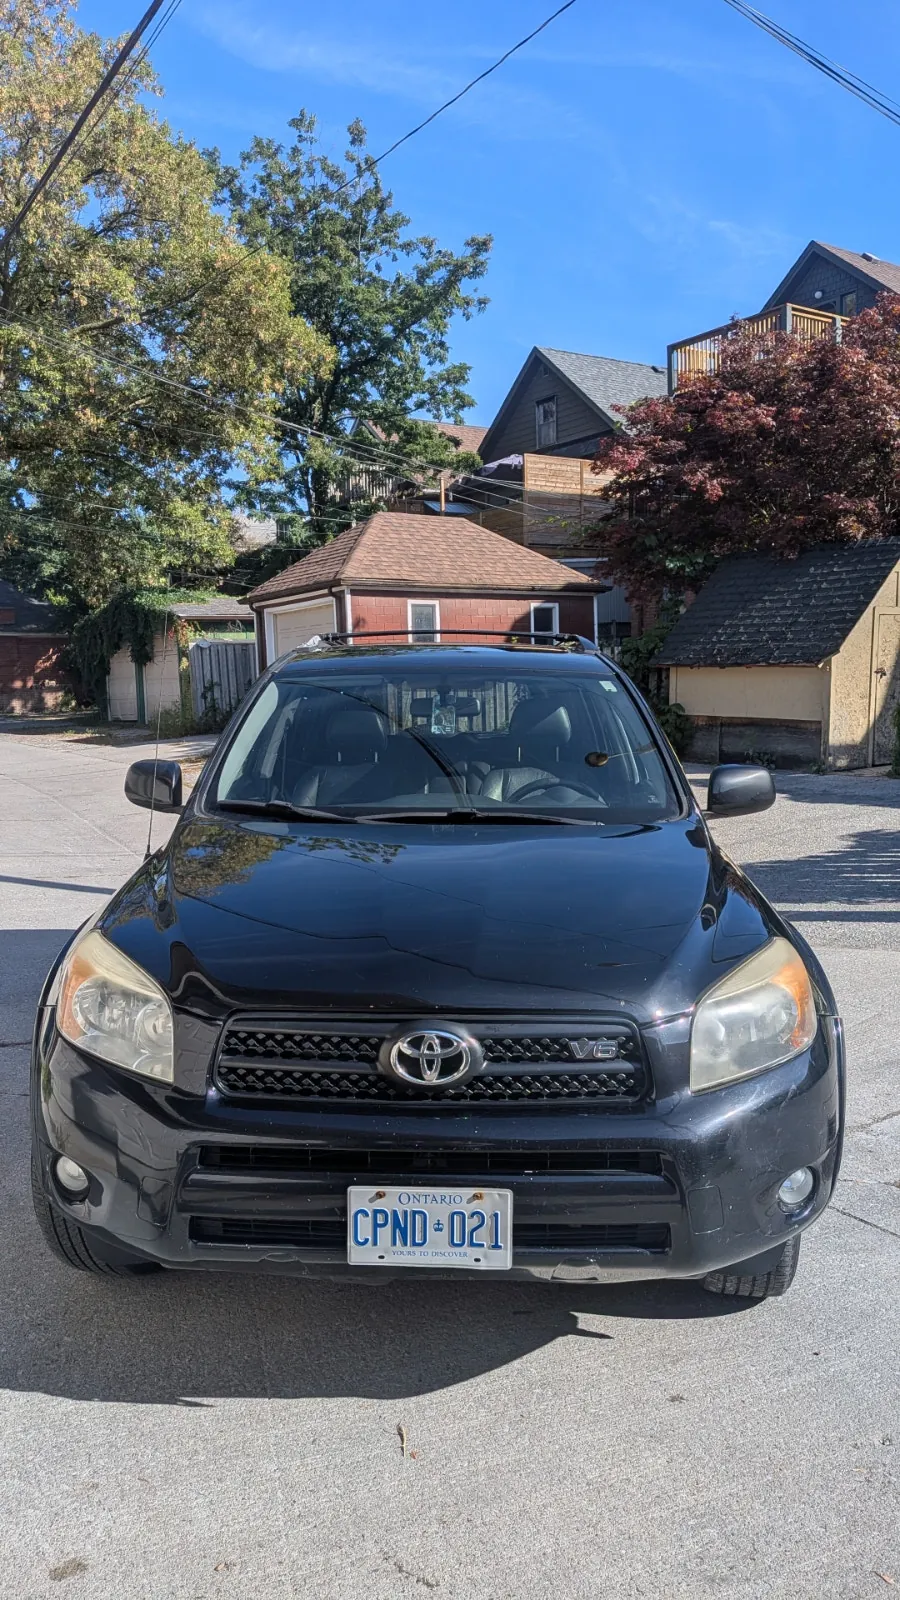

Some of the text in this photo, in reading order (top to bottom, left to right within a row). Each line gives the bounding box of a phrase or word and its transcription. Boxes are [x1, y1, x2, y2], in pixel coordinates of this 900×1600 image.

[570, 1041, 619, 1058] V6
[353, 1208, 503, 1250] CPND 021
